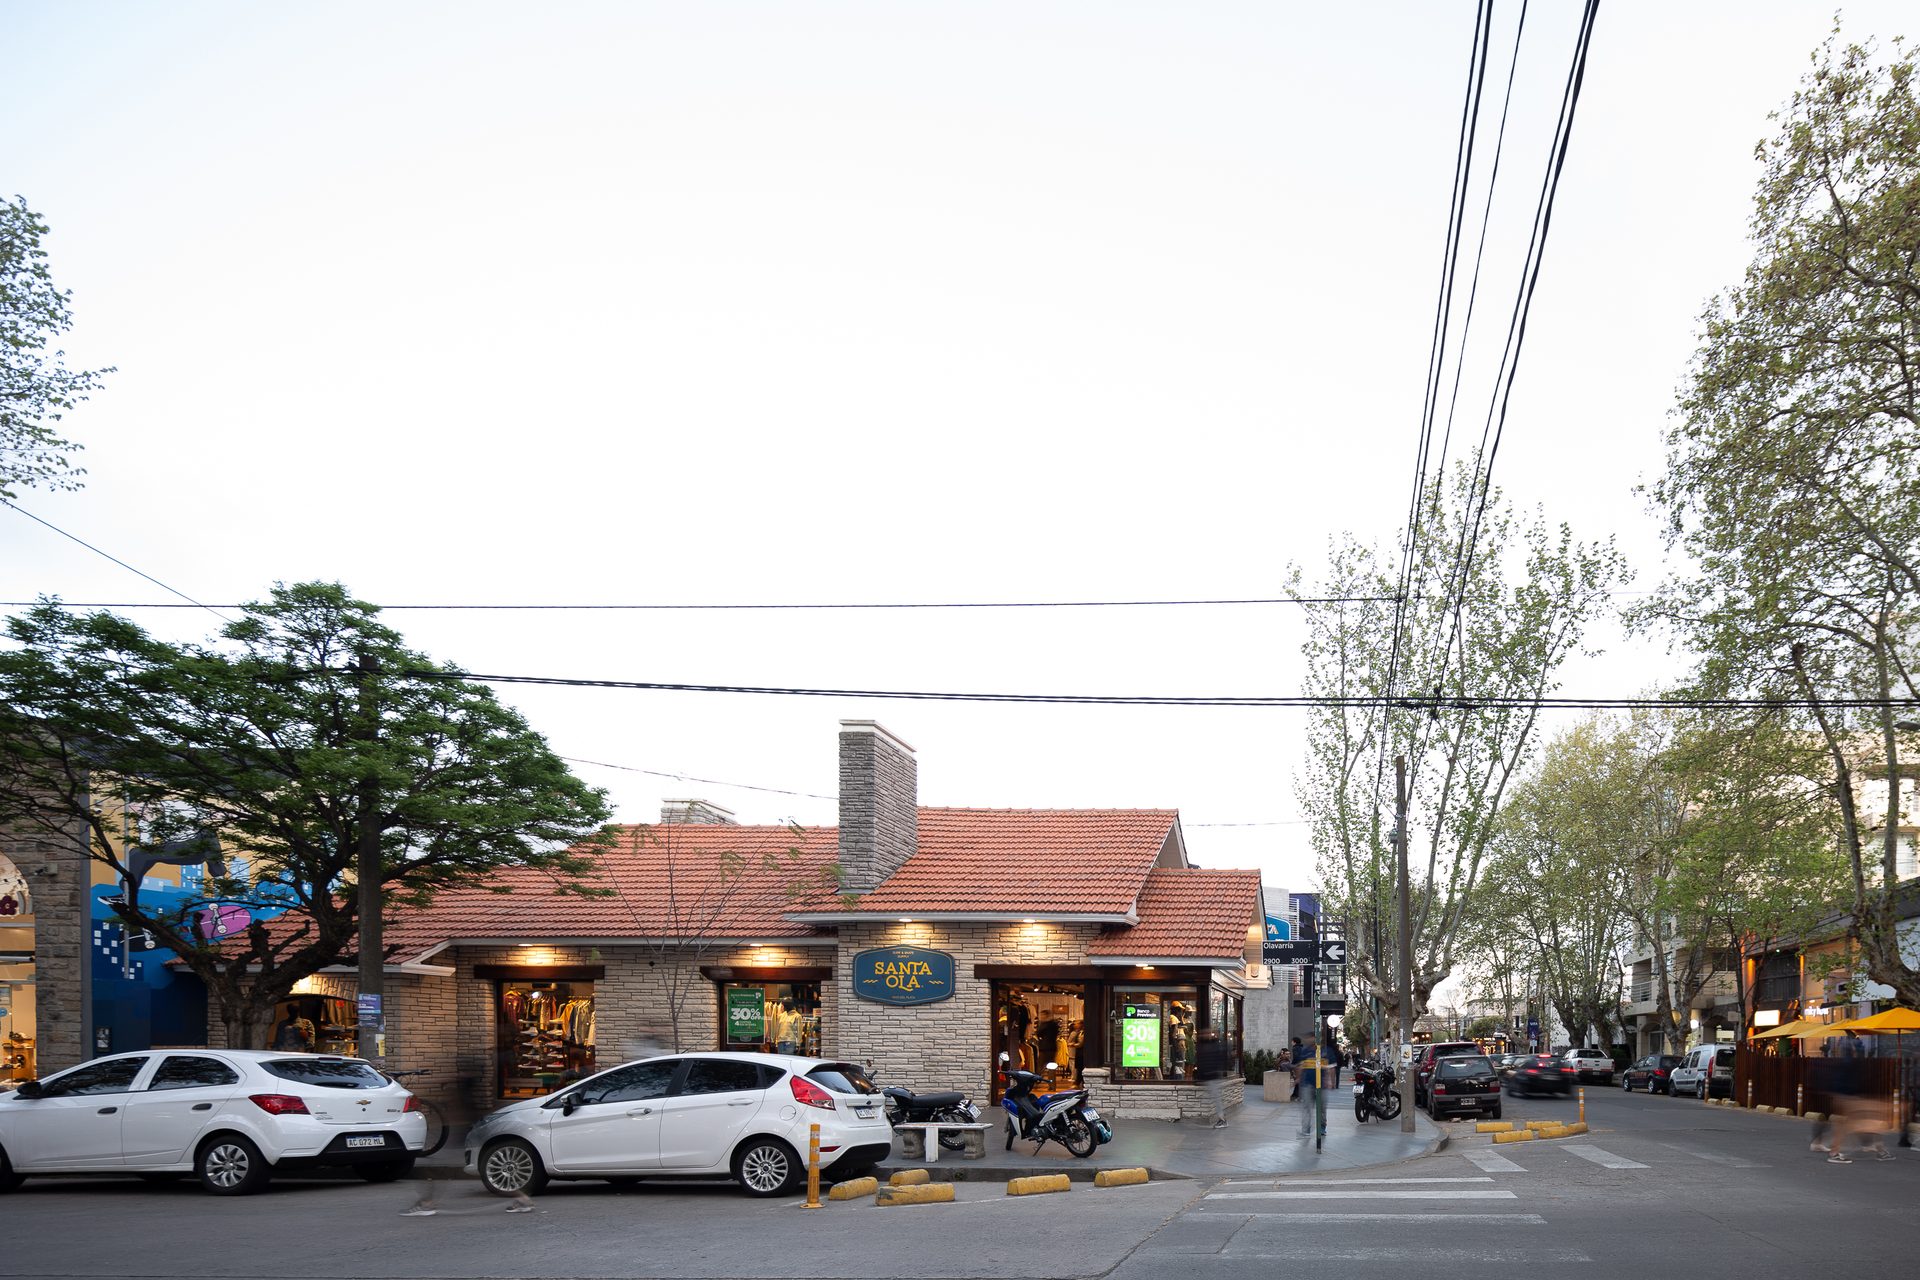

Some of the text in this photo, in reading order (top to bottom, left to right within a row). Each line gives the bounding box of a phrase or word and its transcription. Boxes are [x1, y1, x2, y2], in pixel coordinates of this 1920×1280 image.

[874, 961, 933, 975] SANTA
[885, 975, 921, 992] OLA
[1126, 1044, 1136, 1057] 4
